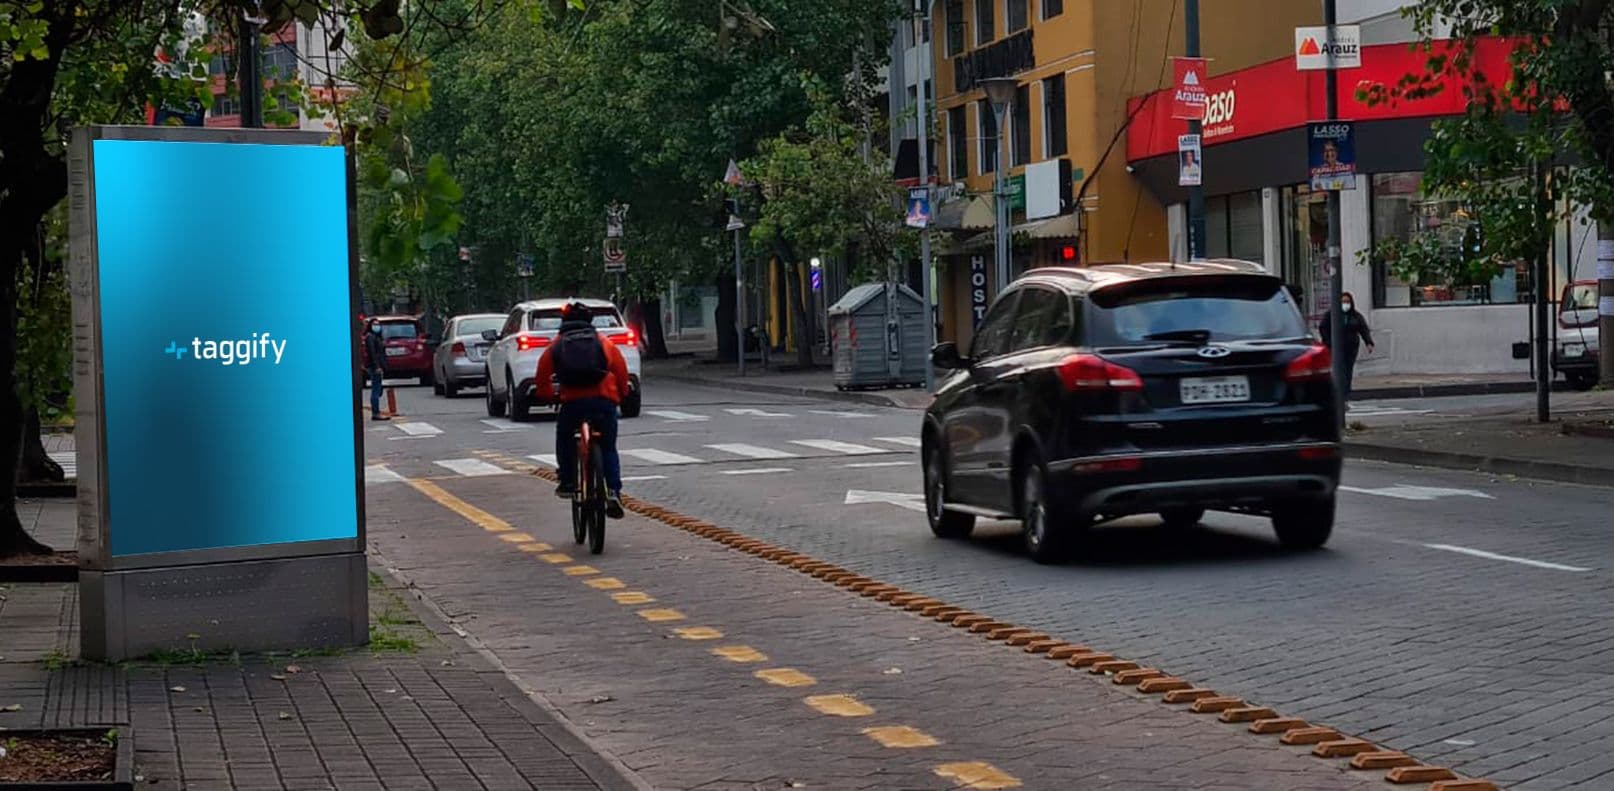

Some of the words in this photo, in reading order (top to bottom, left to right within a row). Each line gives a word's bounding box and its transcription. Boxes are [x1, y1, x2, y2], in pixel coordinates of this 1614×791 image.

[1321, 43, 1357, 55] Arauz
[1176, 90, 1205, 102] Arauz
[1314, 125, 1350, 134] LASSO
[192, 332, 287, 365] taggify
